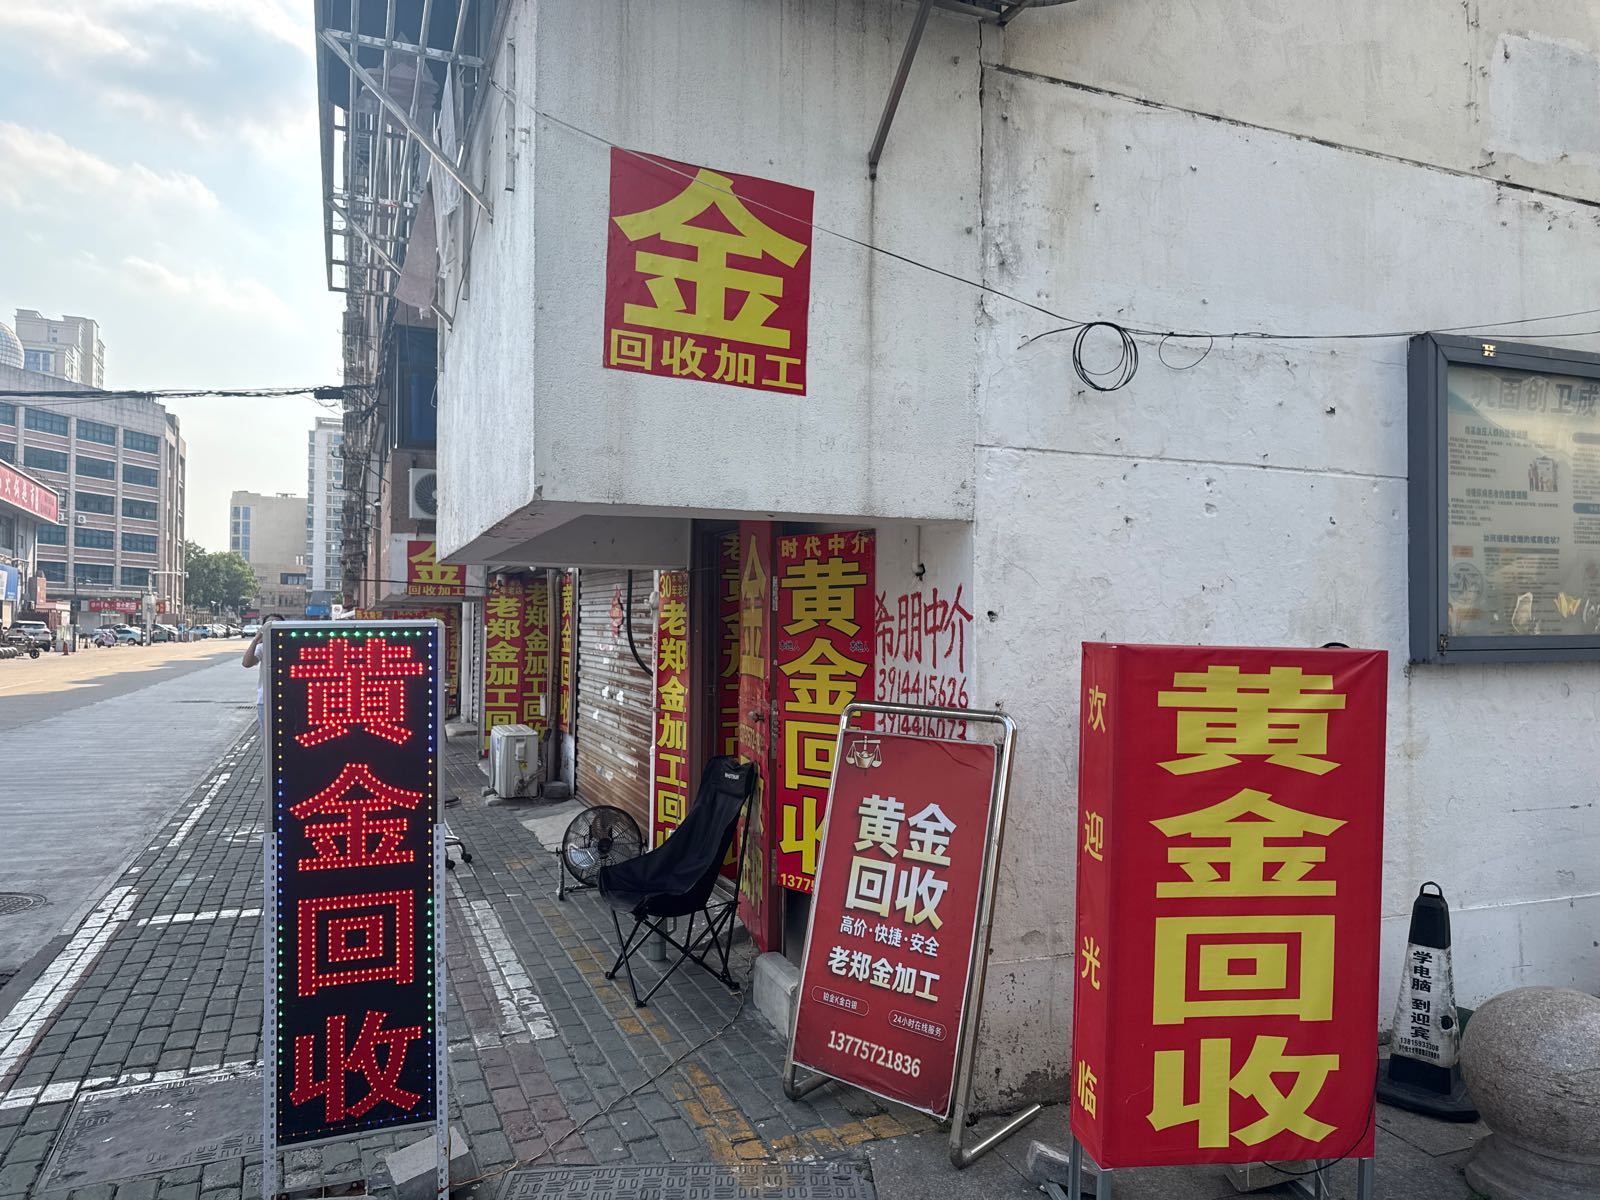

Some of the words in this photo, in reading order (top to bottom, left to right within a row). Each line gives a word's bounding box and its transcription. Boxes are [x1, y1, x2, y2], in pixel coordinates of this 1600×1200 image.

[612, 168, 808, 349] 金
[610, 328, 803, 390] 回收加工
[409, 541, 460, 584] 金
[781, 532, 869, 558] 时代中介
[408, 585, 464, 596] 回收加工
[485, 595, 522, 750] 老郑金加工回
[655, 600, 688, 848] 老郑金加工回
[853, 795, 957, 867] 黄金
[290, 638, 423, 1123] 黄金回收
[845, 855, 948, 930] 回收
[1077, 685, 1107, 1121] 欢迎光临
[1147, 666, 1348, 1148] 黄金回收
[828, 946, 940, 1002] 老郑金加工
[1411, 950, 1432, 993] 学电脑
[892, 1014, 942, 1037] 24小时在线服务
[1411, 998, 1431, 1040] 到迎宾
[827, 1030, 922, 1078] 13775721836
